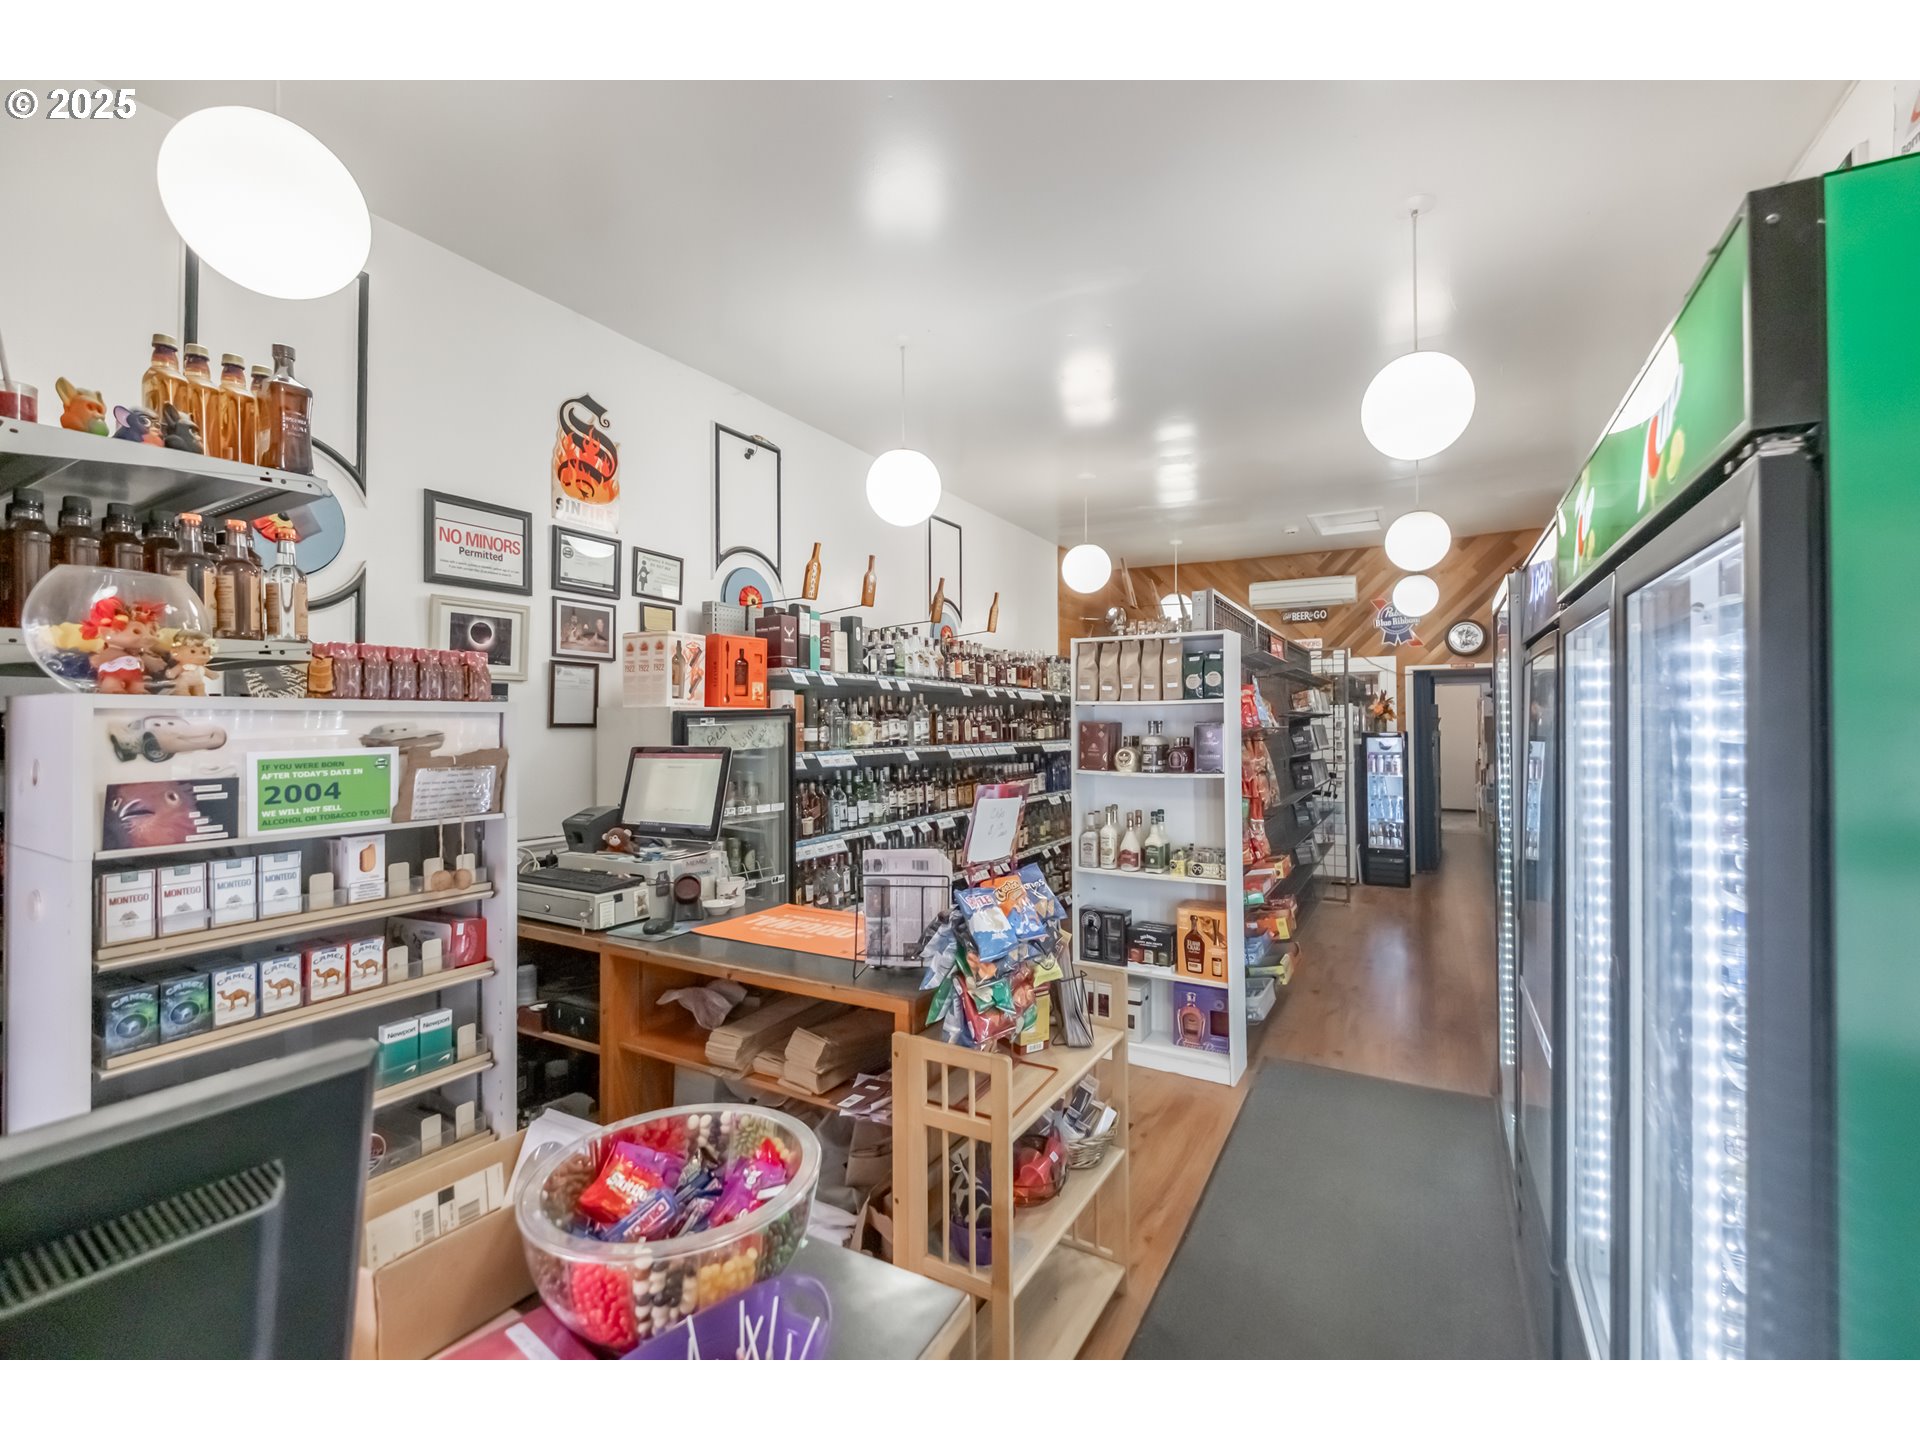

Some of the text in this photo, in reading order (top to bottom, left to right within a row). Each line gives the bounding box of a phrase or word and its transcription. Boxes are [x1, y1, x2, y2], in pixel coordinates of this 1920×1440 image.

[439, 526, 521, 556] NO MINORS
[458, 546, 504, 562] Permitted
[1292, 611, 1312, 621] BEER
[1313, 610, 1327, 619] GO
[1375, 616, 1418, 627] Blue Ribbon
[273, 763, 292, 771] YOU
[261, 771, 290, 780] AFTER
[293, 769, 329, 779] TODAY'S
[330, 768, 352, 776] DATE
[263, 781, 342, 806] 2004
[261, 810, 277, 818] WE
[278, 808, 302, 816] WILL
[303, 806, 321, 814] NOT
[261, 817, 303, 827] ALCOHOL
[320, 811, 358, 821] TOBACCO
[371, 808, 388, 816] YOU
[265, 872, 297, 882] MONTEGO
[217, 879, 252, 890] MONTEGO
[164, 886, 201, 898] MONTEGO
[109, 893, 150, 906] MONTEGO
[351, 943, 382, 956] CAMEL
[313, 953, 344, 966] CAMEL
[263, 963, 298, 976] CAMEL
[216, 973, 254, 987] CAMEL
[165, 980, 206, 996] CAMEL
[111, 991, 153, 1009] CAMEL
[423, 1016, 450, 1028] Newport
[387, 1026, 416, 1039] Newport
[606, 1171, 649, 1203] Skittle
